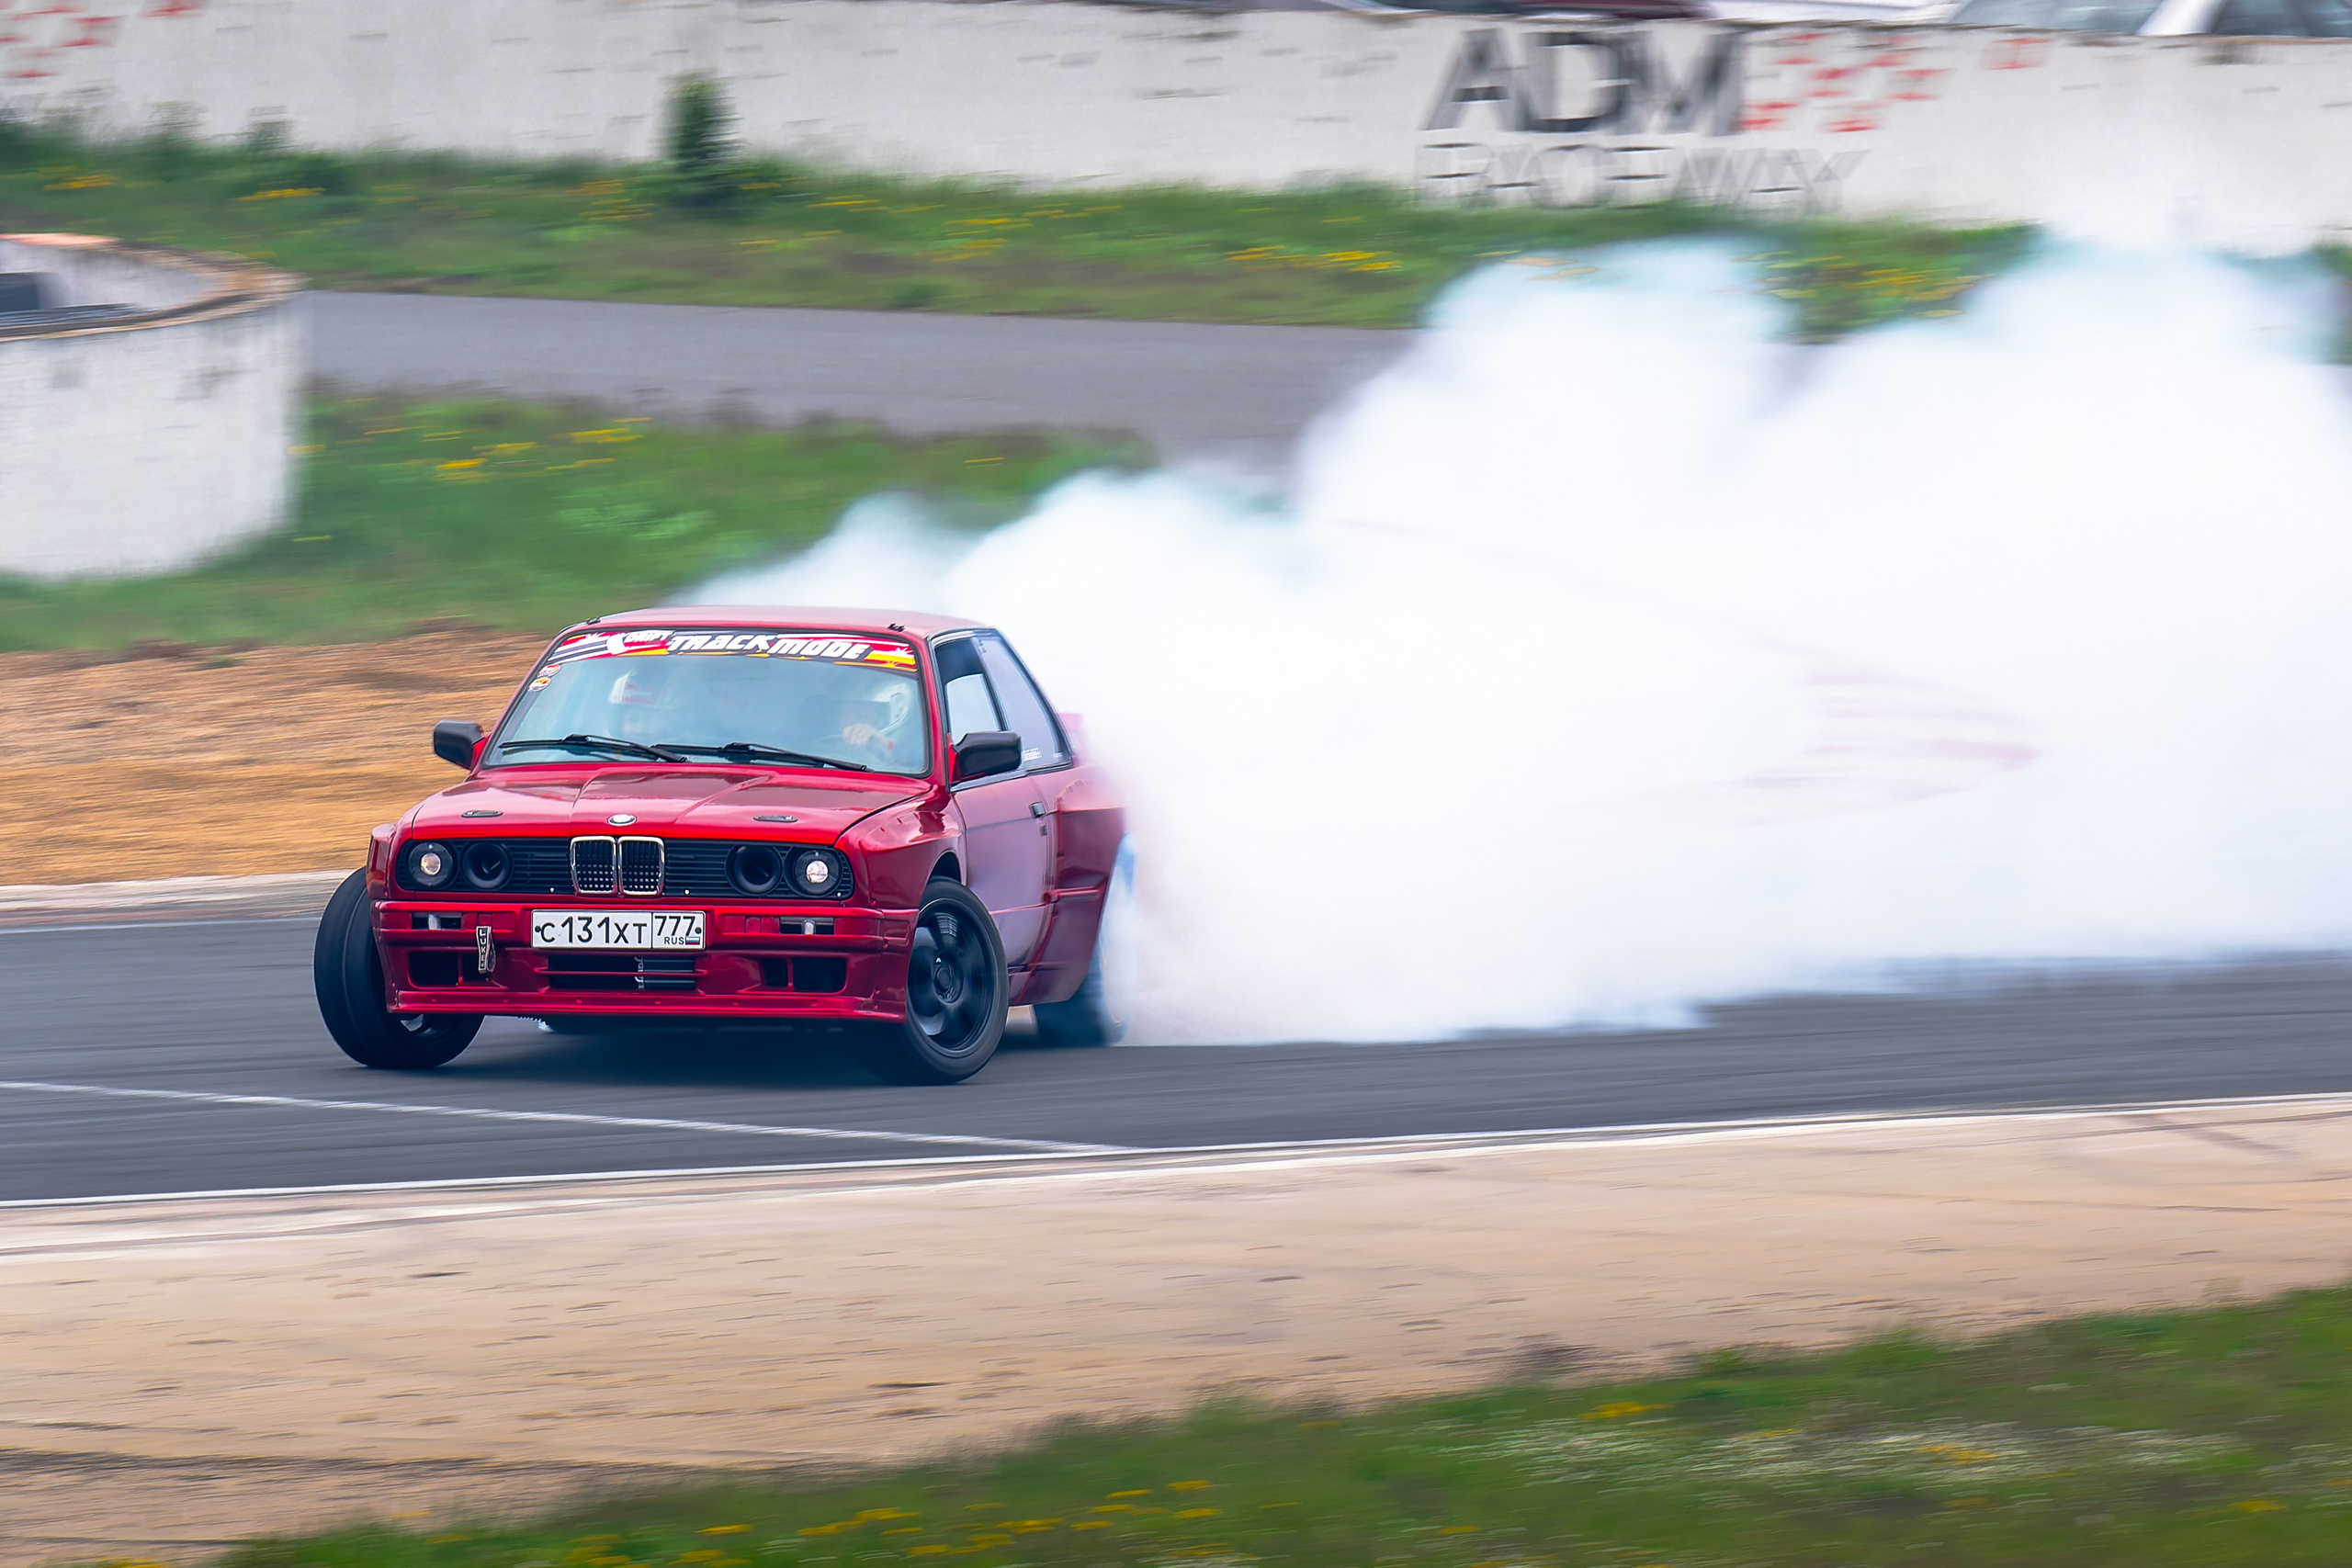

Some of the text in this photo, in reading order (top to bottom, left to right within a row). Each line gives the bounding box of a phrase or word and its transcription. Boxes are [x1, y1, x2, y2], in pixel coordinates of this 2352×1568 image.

[1418, 28, 1744, 136] ADM
[654, 915, 696, 937] 777
[663, 936, 684, 945] RUS
